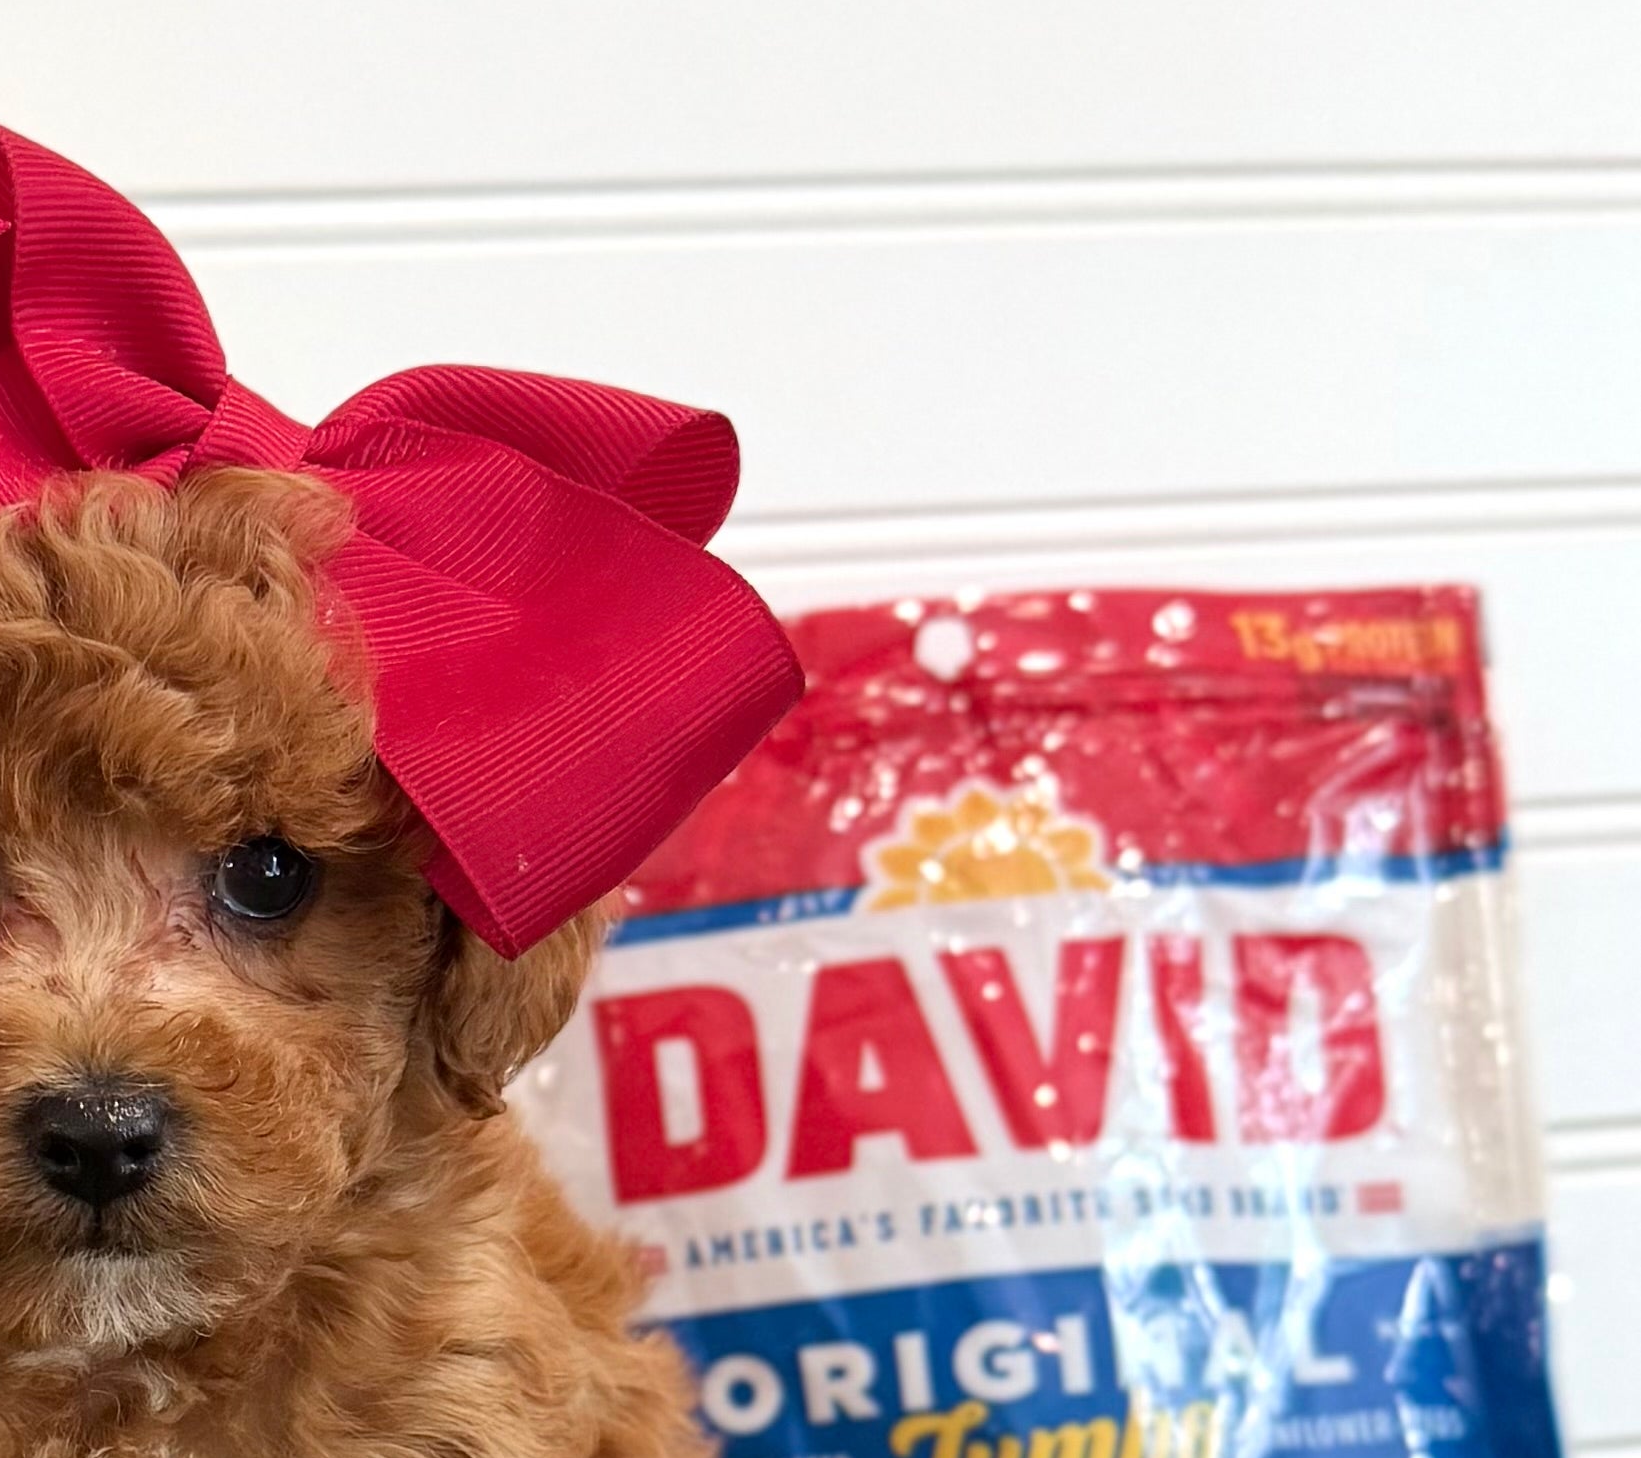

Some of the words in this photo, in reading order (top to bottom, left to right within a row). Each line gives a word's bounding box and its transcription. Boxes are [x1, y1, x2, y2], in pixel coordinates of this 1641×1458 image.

[591, 933, 1386, 1206] DAVID
[686, 1212, 895, 1268] AMERICA'S
[1246, 1408, 1394, 1451] NFLOWER
